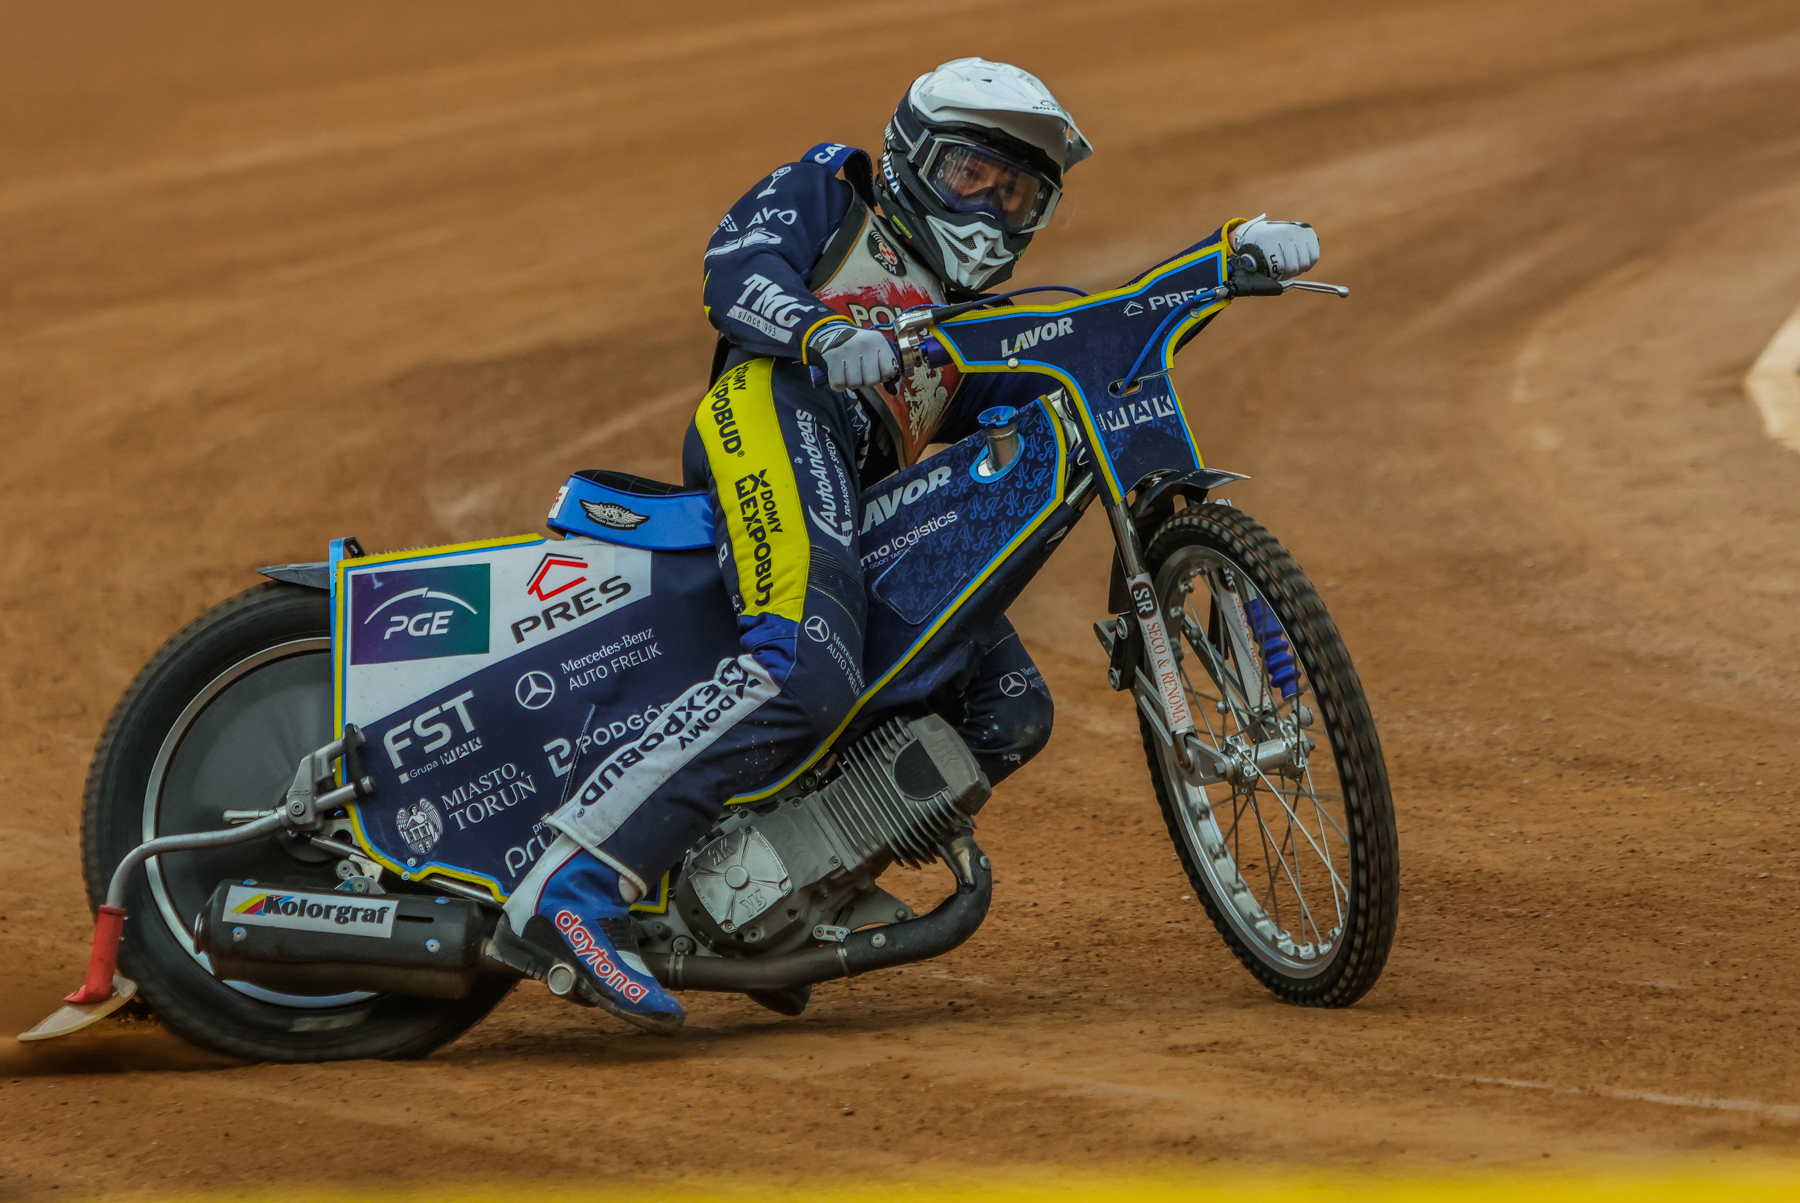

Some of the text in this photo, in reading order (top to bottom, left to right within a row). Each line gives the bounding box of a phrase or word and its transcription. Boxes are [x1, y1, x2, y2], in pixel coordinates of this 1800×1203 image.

[738, 311, 777, 337] since 1993
[1000, 317, 1074, 358] LAVOR
[796, 409, 838, 528] AutoAndreas
[760, 489, 783, 533] DOMY
[858, 465, 952, 536] AVOR
[891, 510, 958, 548] logistics
[510, 575, 632, 644] PRES
[1133, 587, 1154, 614] SR
[383, 610, 454, 640] PGE
[1147, 622, 1166, 654] SECO
[1157, 659, 1171, 669] &
[560, 628, 655, 674] Mercedes-Benz
[568, 642, 662, 691] AUTO FRELIK
[826, 643, 847, 670] AUTO
[383, 690, 476, 769] FST
[580, 683, 722, 807] EXPOBUD
[677, 695, 737, 751] DOMY
[409, 760, 439, 778] Grupa
[440, 763, 517, 811] MIASTO
[449, 772, 538, 831] TORUŃ
[262, 895, 390, 925] Kolorgraf
[555, 910, 649, 1004] daytona
